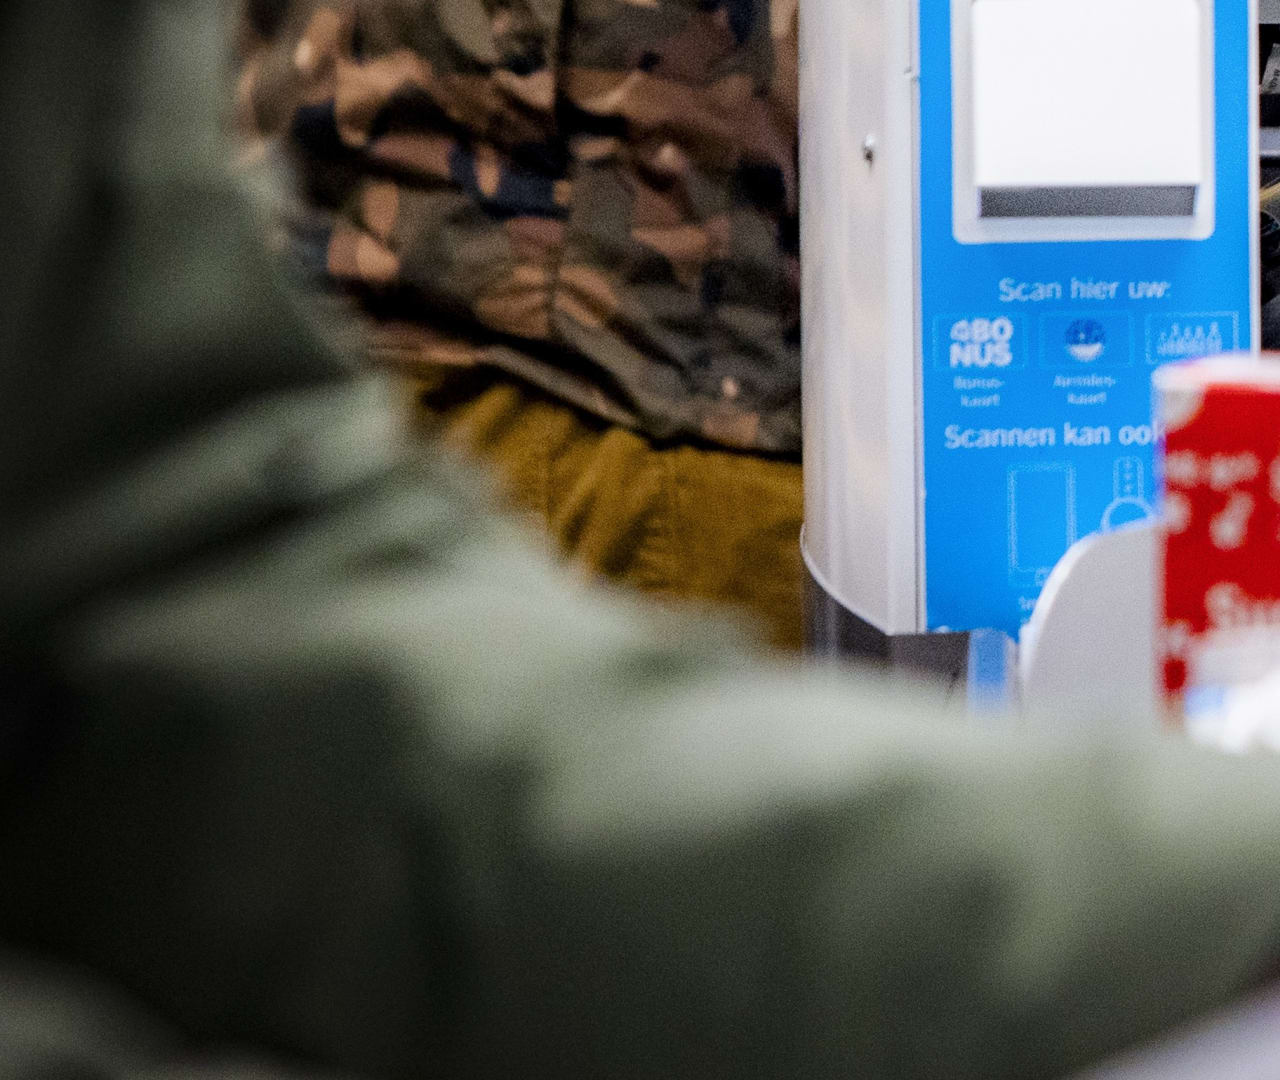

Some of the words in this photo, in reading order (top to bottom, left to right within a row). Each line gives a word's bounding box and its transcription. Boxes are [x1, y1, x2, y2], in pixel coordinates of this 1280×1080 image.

[999, 276, 1062, 302] Scan
[1070, 276, 1119, 301] hier
[950, 342, 1013, 368] NUS
[944, 423, 1056, 449] Scannen
[1064, 422, 1111, 447] kan
